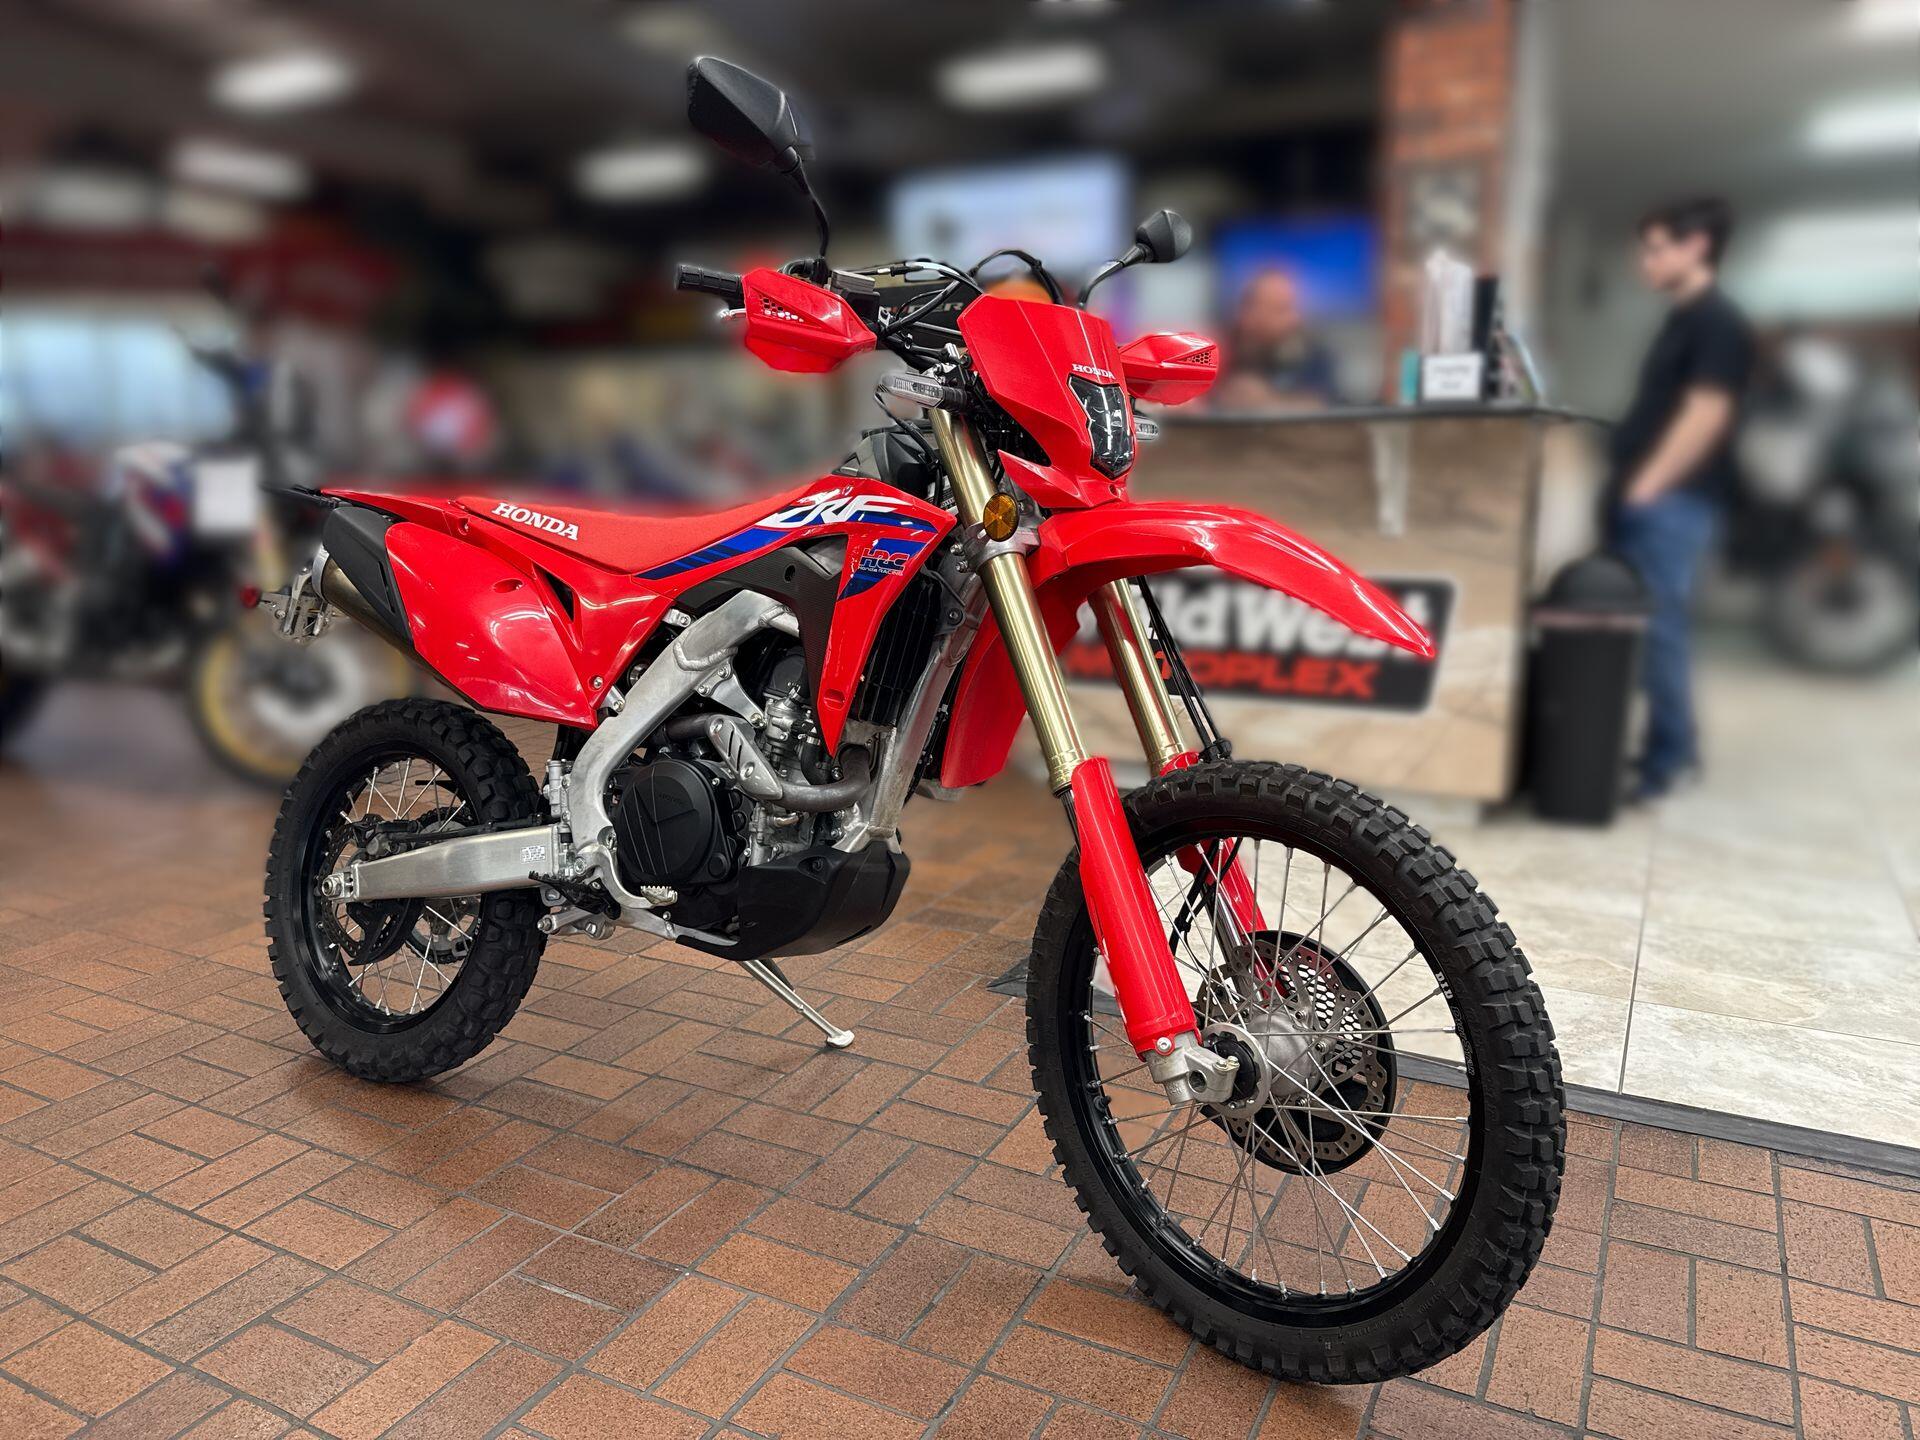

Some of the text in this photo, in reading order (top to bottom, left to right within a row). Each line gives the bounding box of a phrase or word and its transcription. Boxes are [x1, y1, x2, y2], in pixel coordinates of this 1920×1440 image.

[1071, 363, 1116, 380] HONDA
[491, 502, 580, 541] HONDA
[754, 488, 913, 529] CRF
[859, 547, 910, 572] HRC
